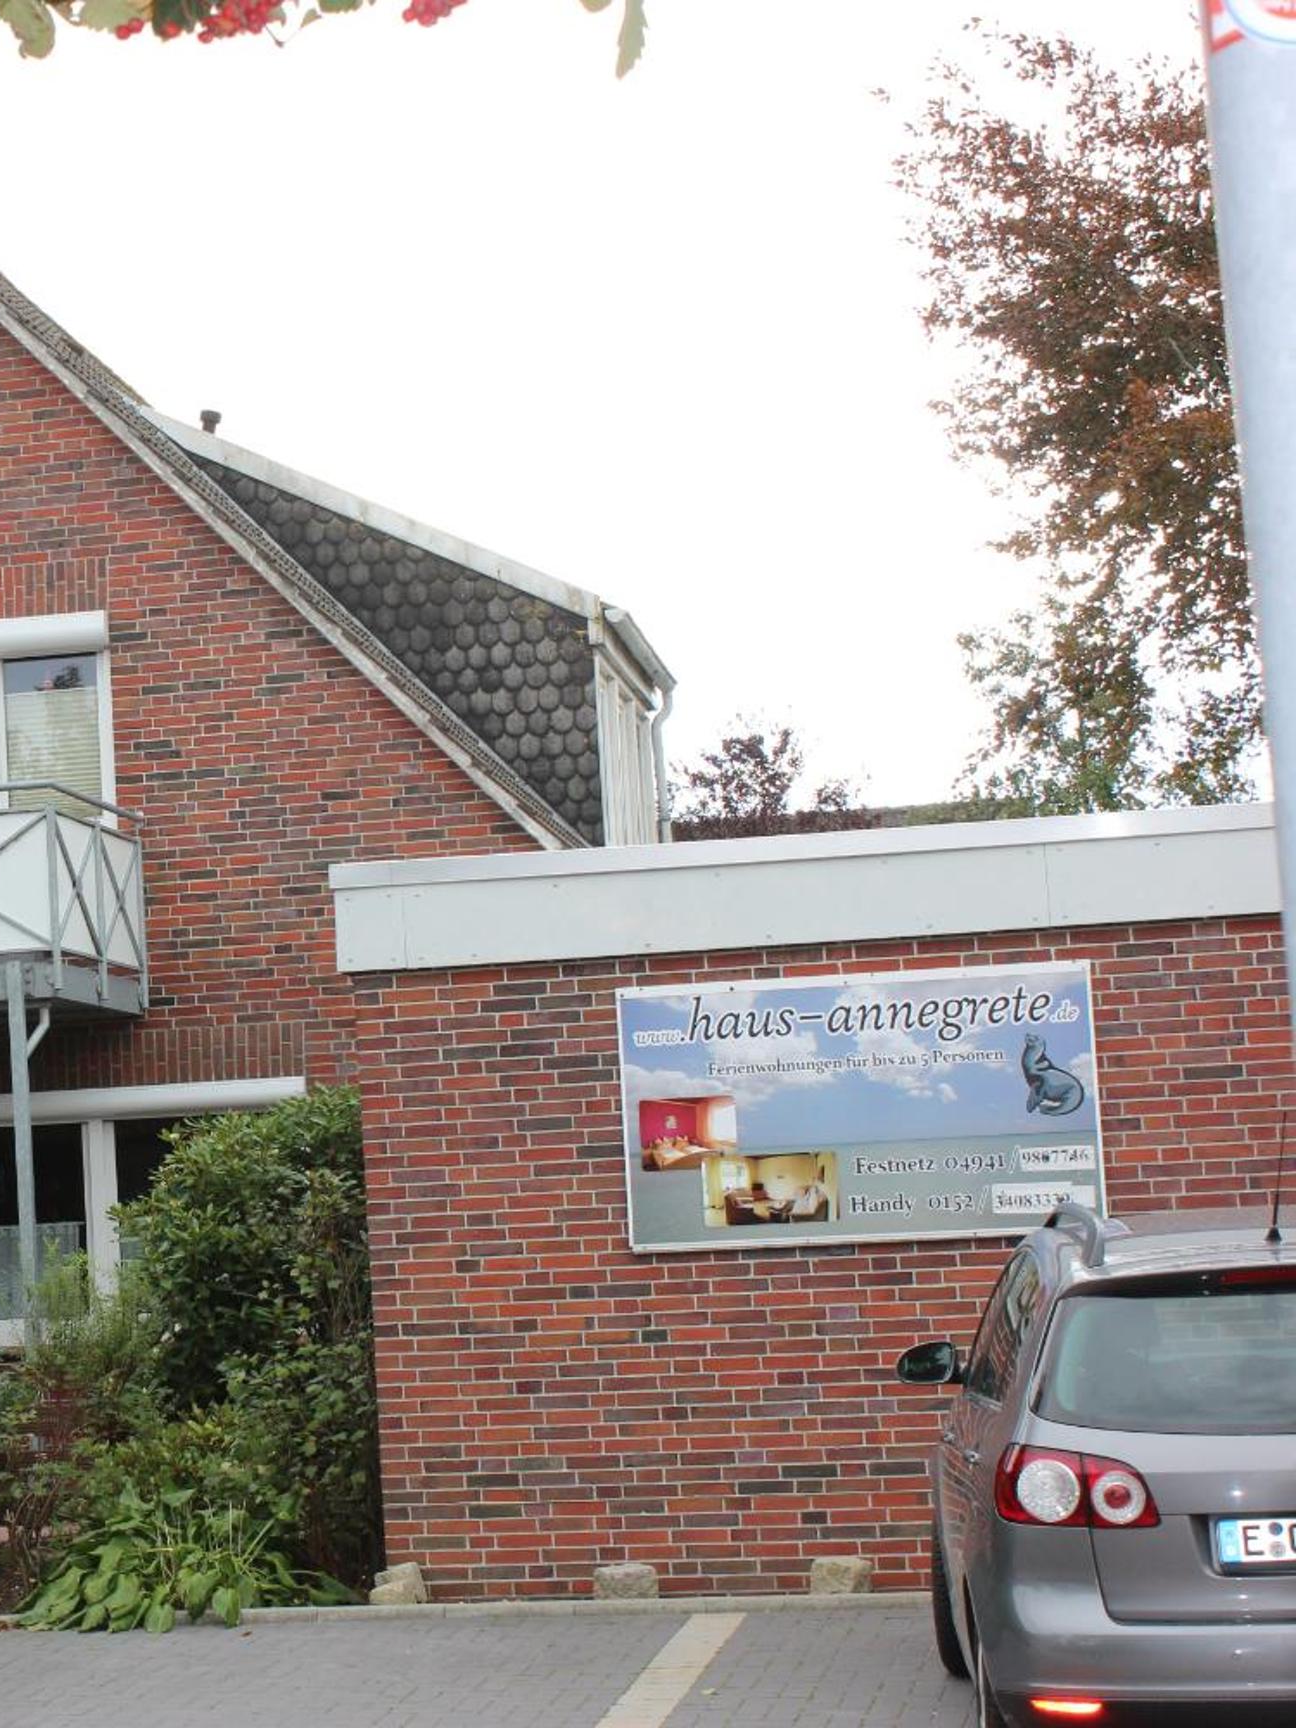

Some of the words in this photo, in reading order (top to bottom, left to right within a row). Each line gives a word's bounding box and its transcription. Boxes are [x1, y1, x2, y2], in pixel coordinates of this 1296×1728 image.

[635, 985, 1078, 1045] www.haus-annegrete.de
[708, 1057, 842, 1075] Ferienwohnungen
[872, 1052, 894, 1067] bis
[897, 1053, 916, 1066] zu
[920, 1053, 929, 1067] 5
[933, 1049, 1004, 1064] Personen
[855, 1157, 935, 1174] Festnetz
[851, 1193, 913, 1217] Handy
